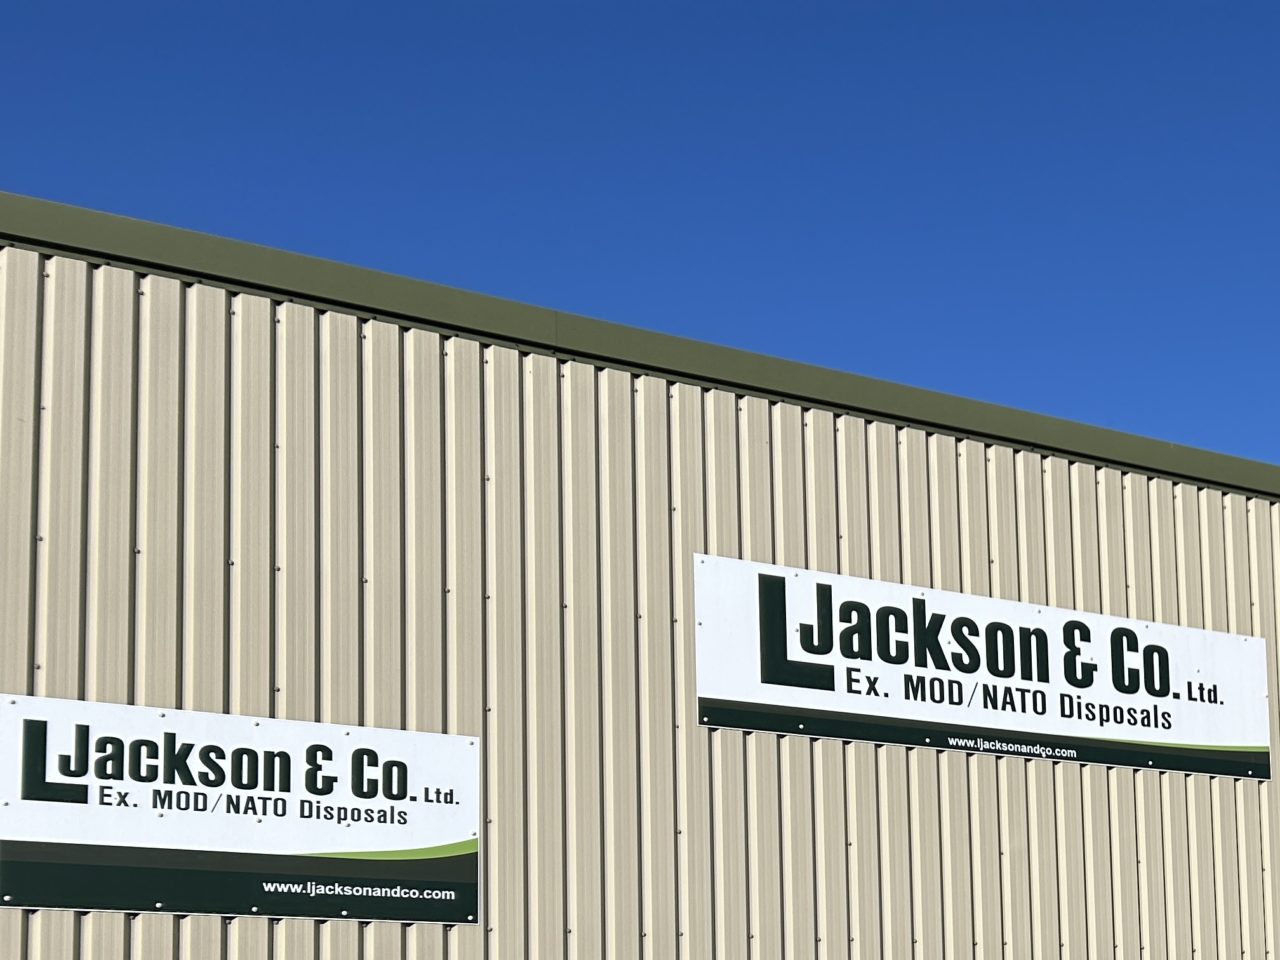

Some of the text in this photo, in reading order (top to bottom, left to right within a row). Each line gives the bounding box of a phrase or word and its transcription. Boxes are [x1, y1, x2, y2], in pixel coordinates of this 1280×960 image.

[1063, 620, 1097, 689] &
[1111, 627, 1180, 700] Co.
[1187, 681, 1223, 706] Ltd.
[847, 667, 888, 697] Ex.
[1060, 693, 1171, 730] Disposals
[948, 737, 1077, 758] www.ljacksonandco.com
[305, 744, 338, 797] &
[351, 748, 417, 801] Co.
[425, 787, 459, 805] Ltd.
[99, 786, 137, 808] Ex.
[300, 799, 407, 825] Disposals
[262, 881, 456, 900] www.ljacksonandco.com
